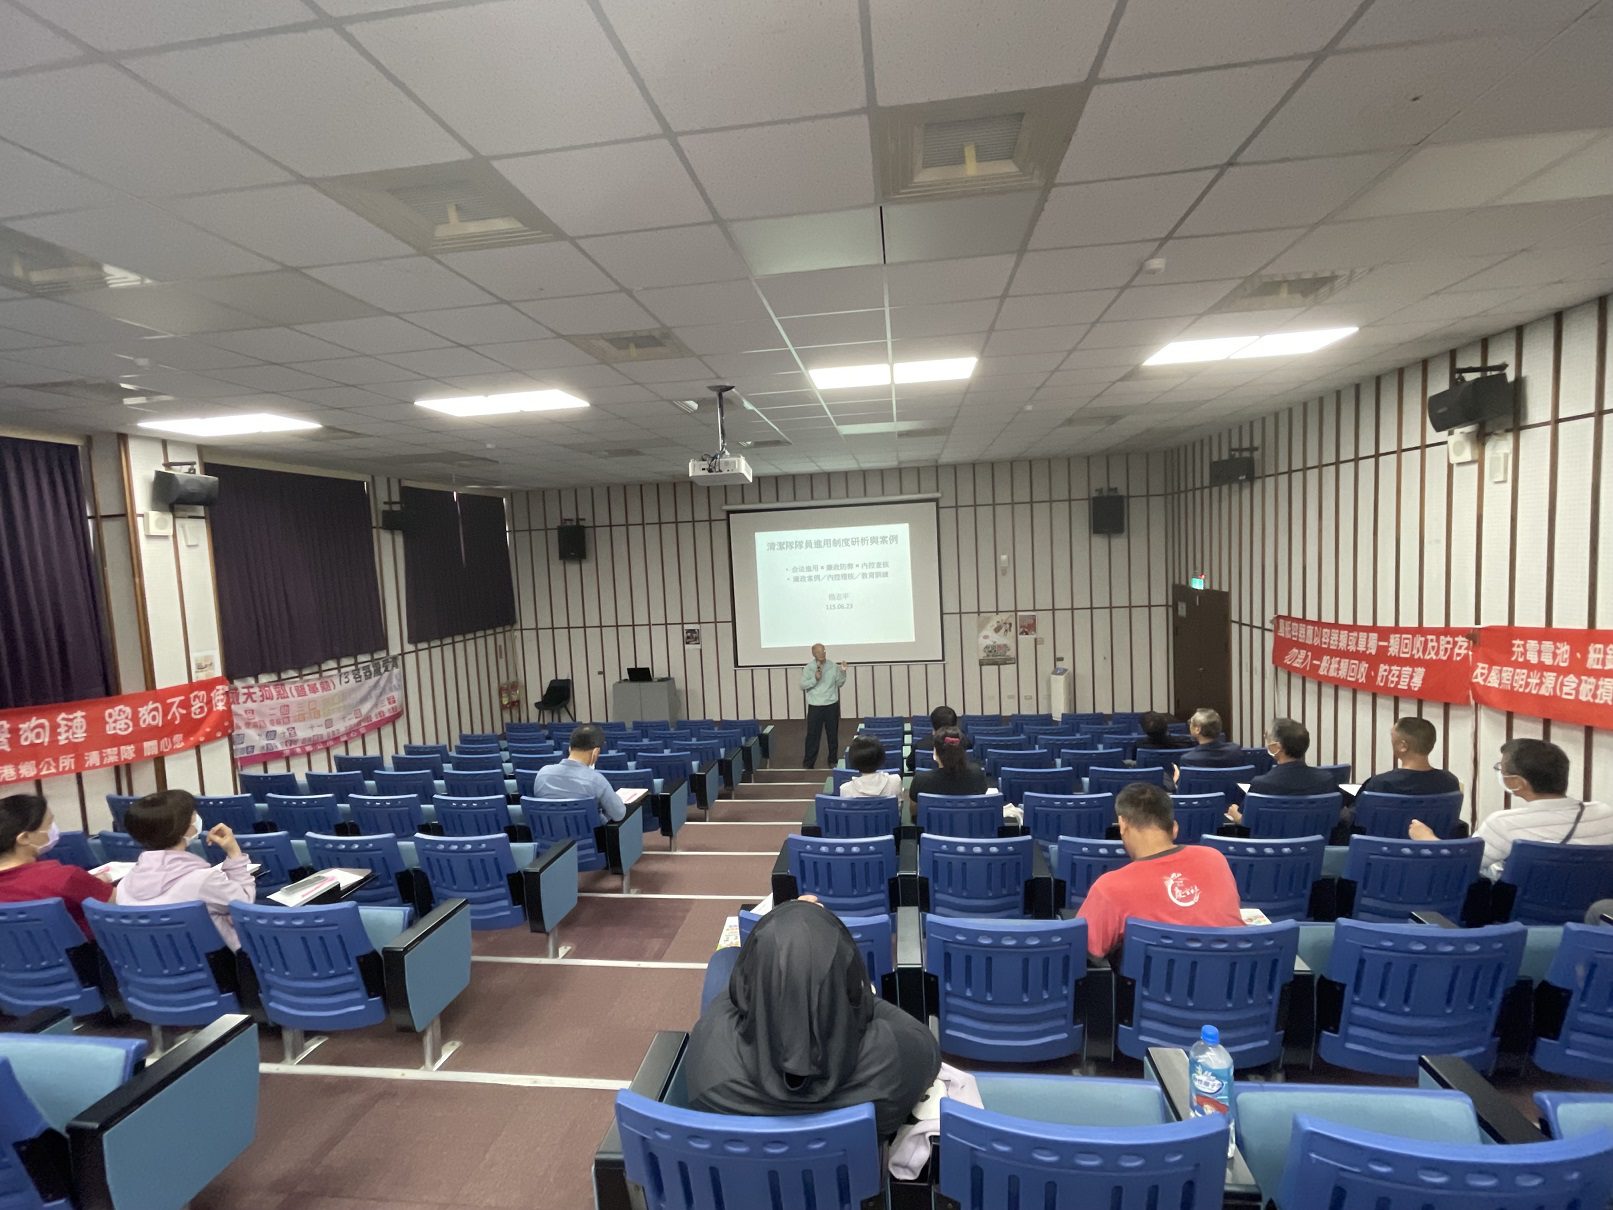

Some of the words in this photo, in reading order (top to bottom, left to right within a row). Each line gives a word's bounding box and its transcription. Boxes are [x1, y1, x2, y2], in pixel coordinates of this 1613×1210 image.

[766, 534, 899, 552] 清潔隊隊員進用制度研析與案例
[84, 745, 136, 768] 清潔隊
